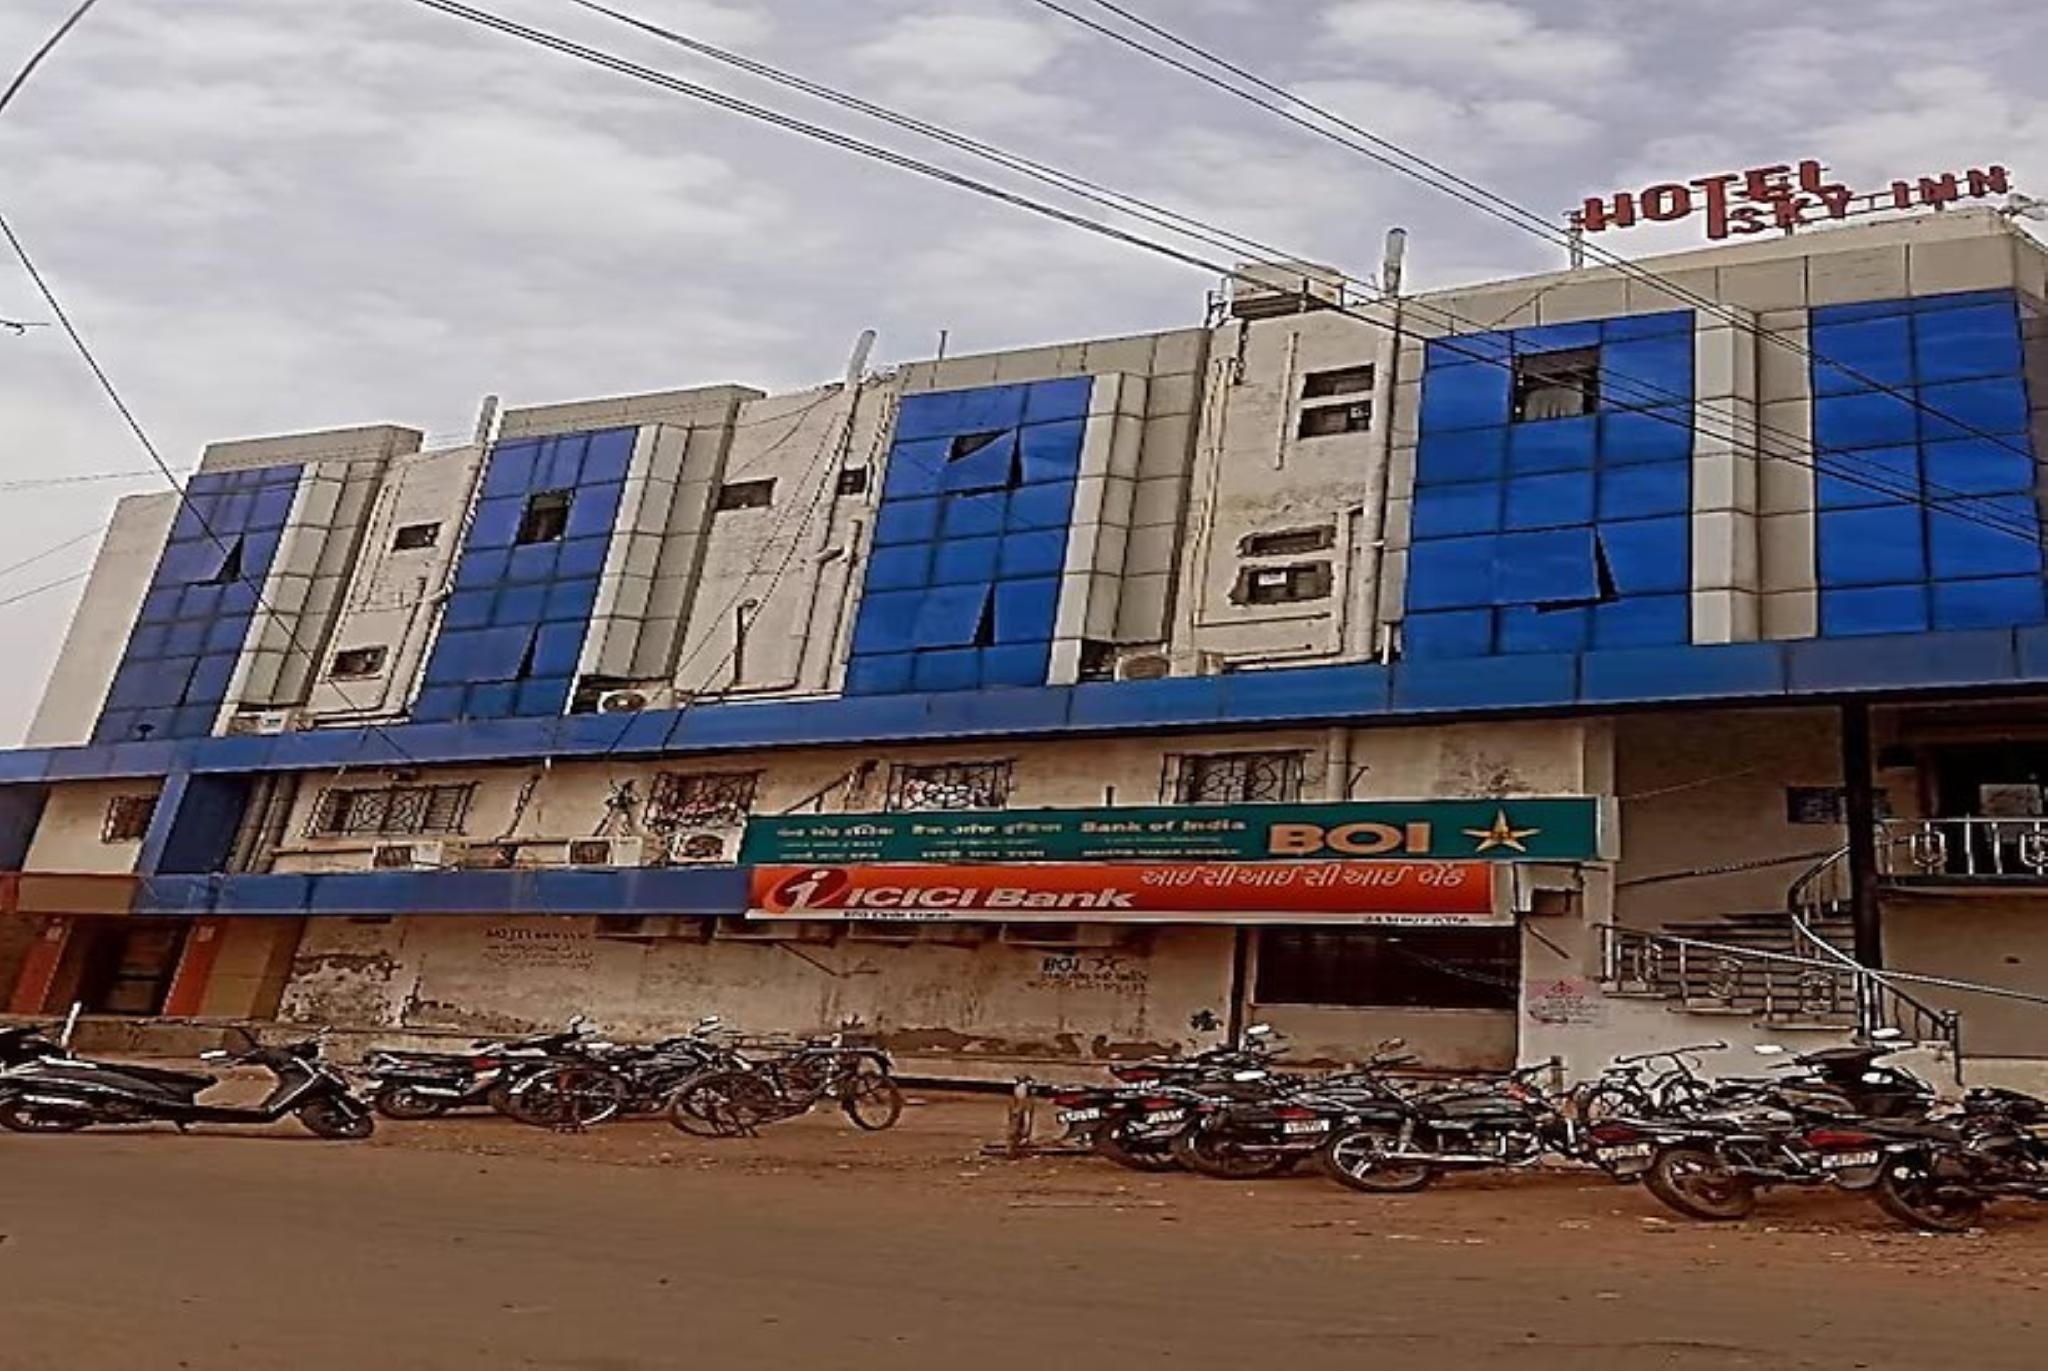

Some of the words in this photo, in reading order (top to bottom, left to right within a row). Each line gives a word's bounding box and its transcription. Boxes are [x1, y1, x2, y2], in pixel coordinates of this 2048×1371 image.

[1584, 160, 1838, 239] HOTEL
[1731, 185, 1851, 234] SKY
[1893, 166, 2009, 209] INN
[1080, 820, 1143, 833] Bank
[1147, 820, 1176, 832] of
[1181, 817, 1248, 832] India
[1269, 822, 1432, 854] BOI
[844, 887, 978, 908] ICICI
[984, 886, 1136, 908] Bank
